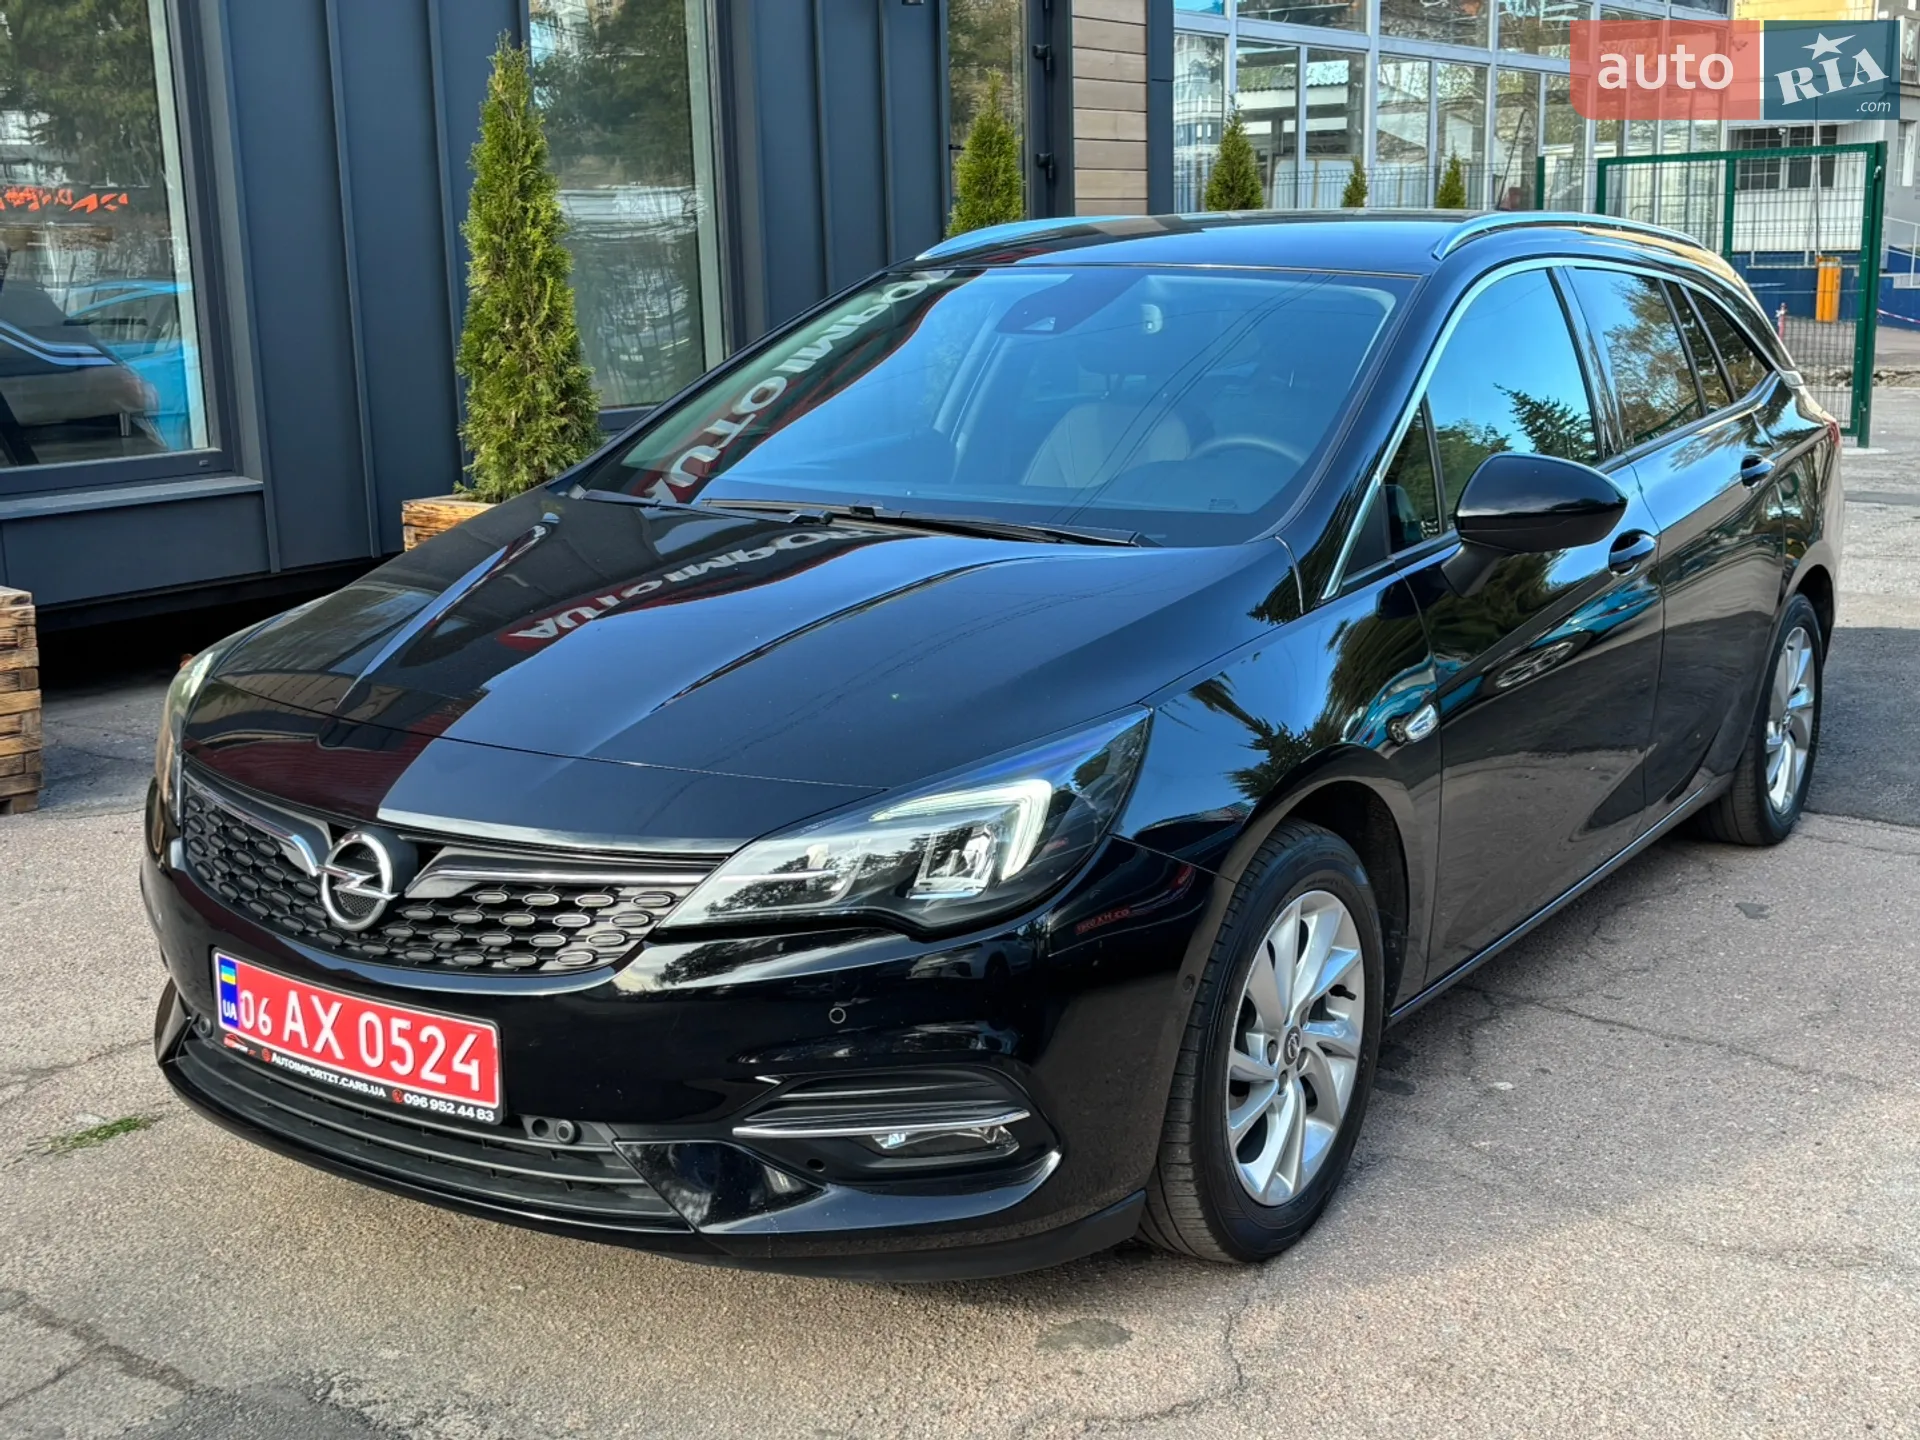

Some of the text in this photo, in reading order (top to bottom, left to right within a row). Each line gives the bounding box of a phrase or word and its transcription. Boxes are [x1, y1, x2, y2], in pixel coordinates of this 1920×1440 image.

[222, 999, 238, 1021] UA
[240, 989, 480, 1092] 06 AX 0524
[403, 1093, 428, 1109] 096
[429, 1098, 455, 1115] 952
[457, 1104, 475, 1119] 44
[475, 1108, 495, 1122] 83
